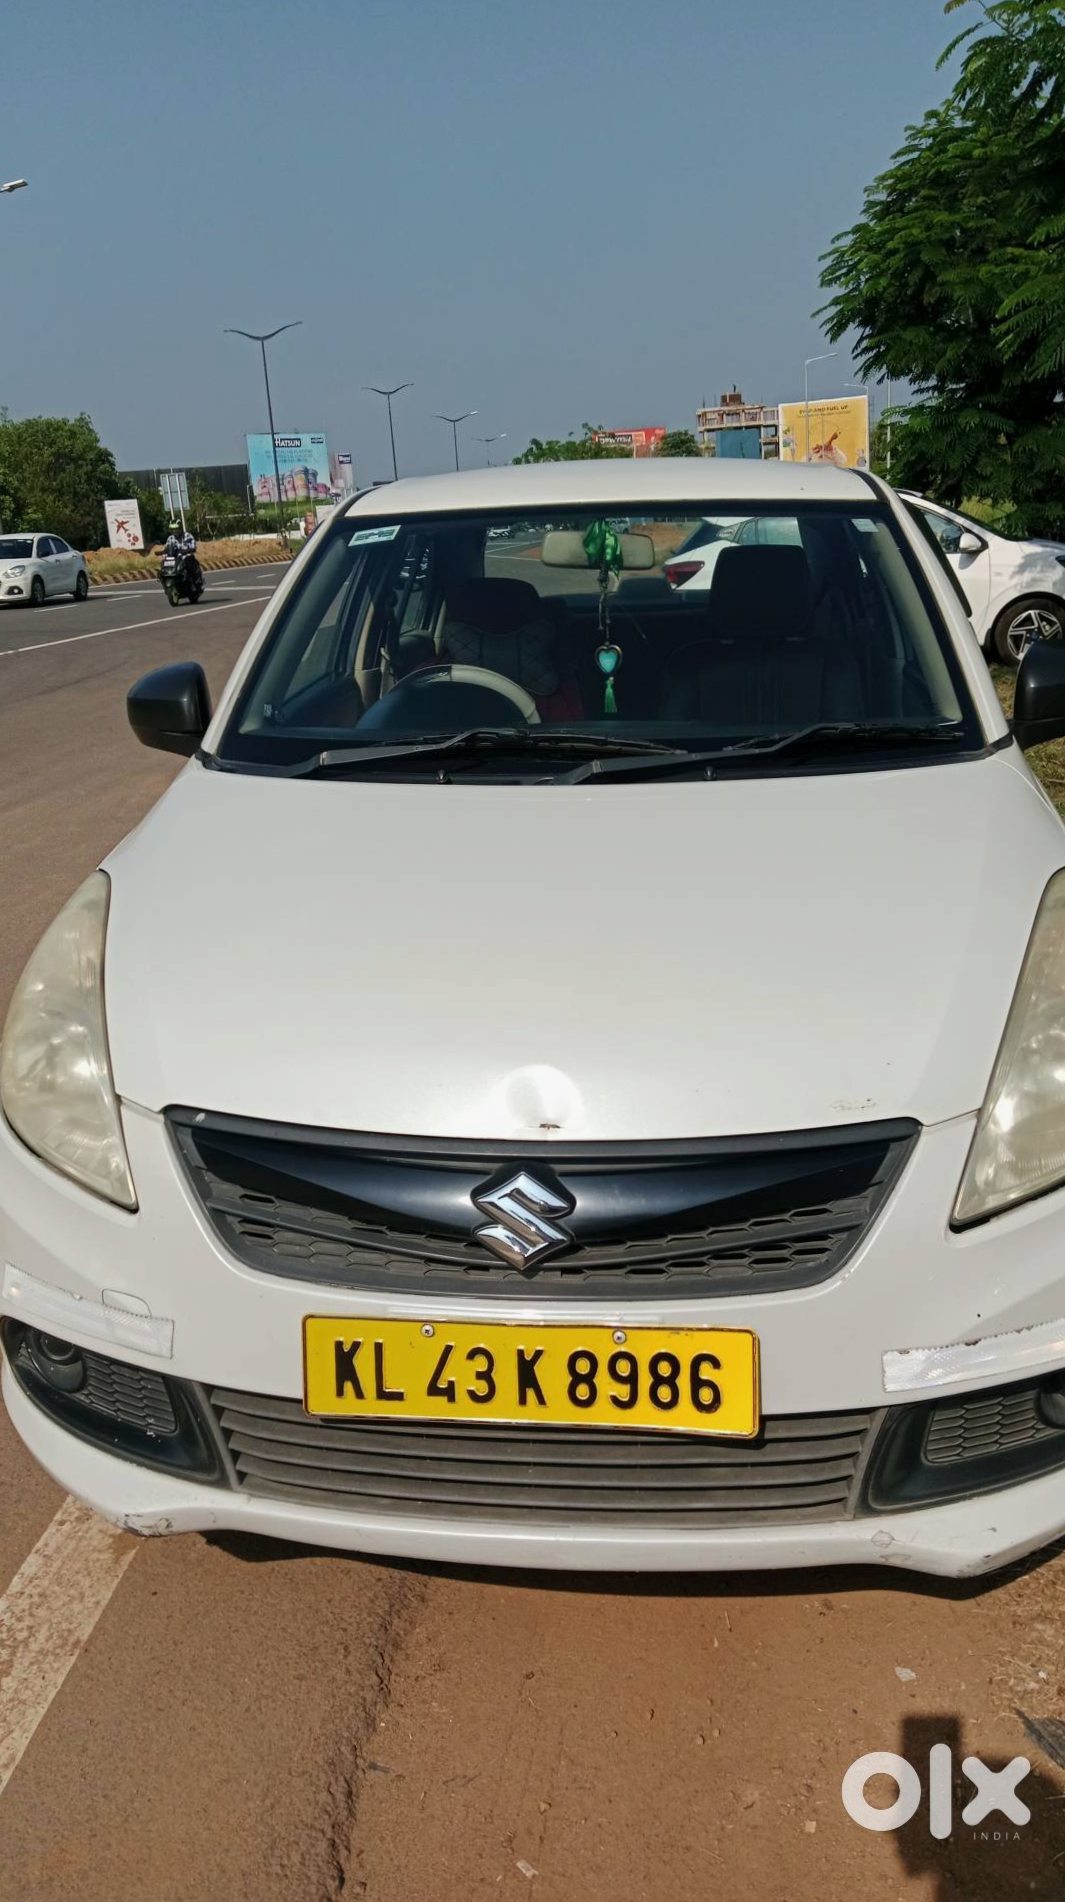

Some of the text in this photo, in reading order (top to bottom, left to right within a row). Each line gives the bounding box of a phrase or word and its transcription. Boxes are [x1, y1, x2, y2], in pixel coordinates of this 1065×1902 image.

[275, 437, 300, 447] HATSUN
[334, 1339, 722, 1414] KL 43 K 8986
